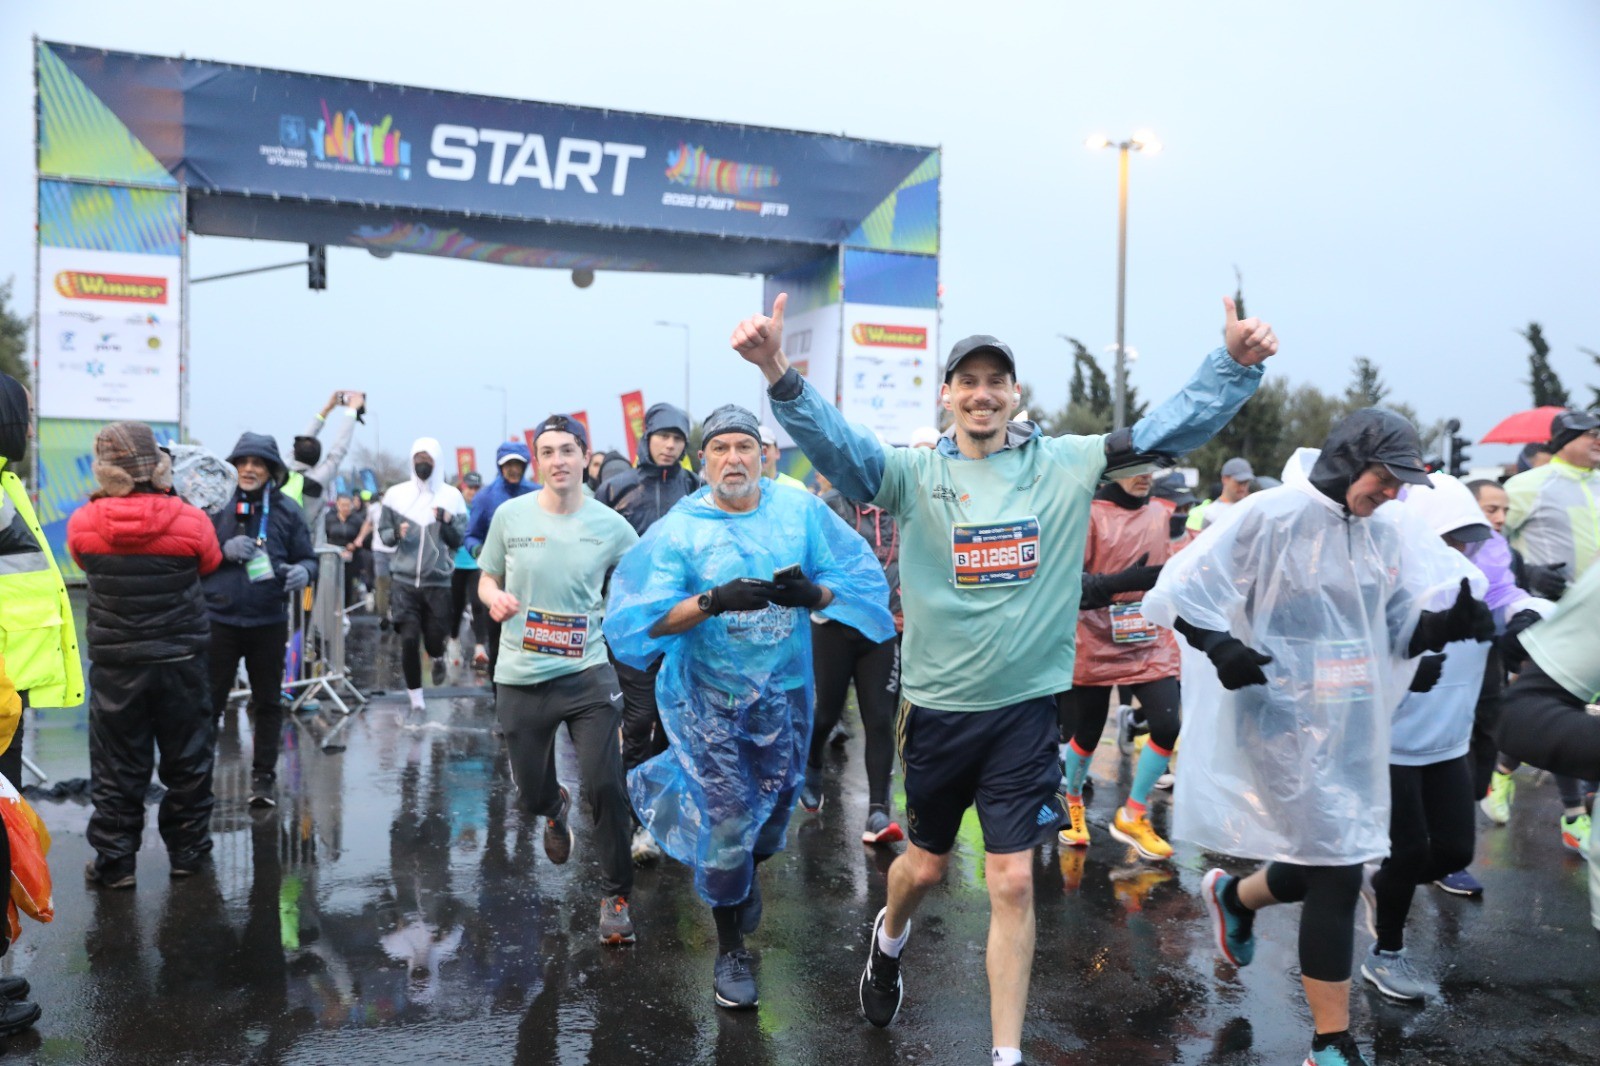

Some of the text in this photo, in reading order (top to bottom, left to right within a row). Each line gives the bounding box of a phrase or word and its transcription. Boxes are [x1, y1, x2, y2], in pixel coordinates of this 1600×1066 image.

[427, 123, 646, 196] START
[661, 192, 696, 207] 2022
[958, 554, 966, 566] B
[969, 546, 1018, 569] 21265
[526, 629, 533, 637] A
[534, 628, 569, 645] 22430
